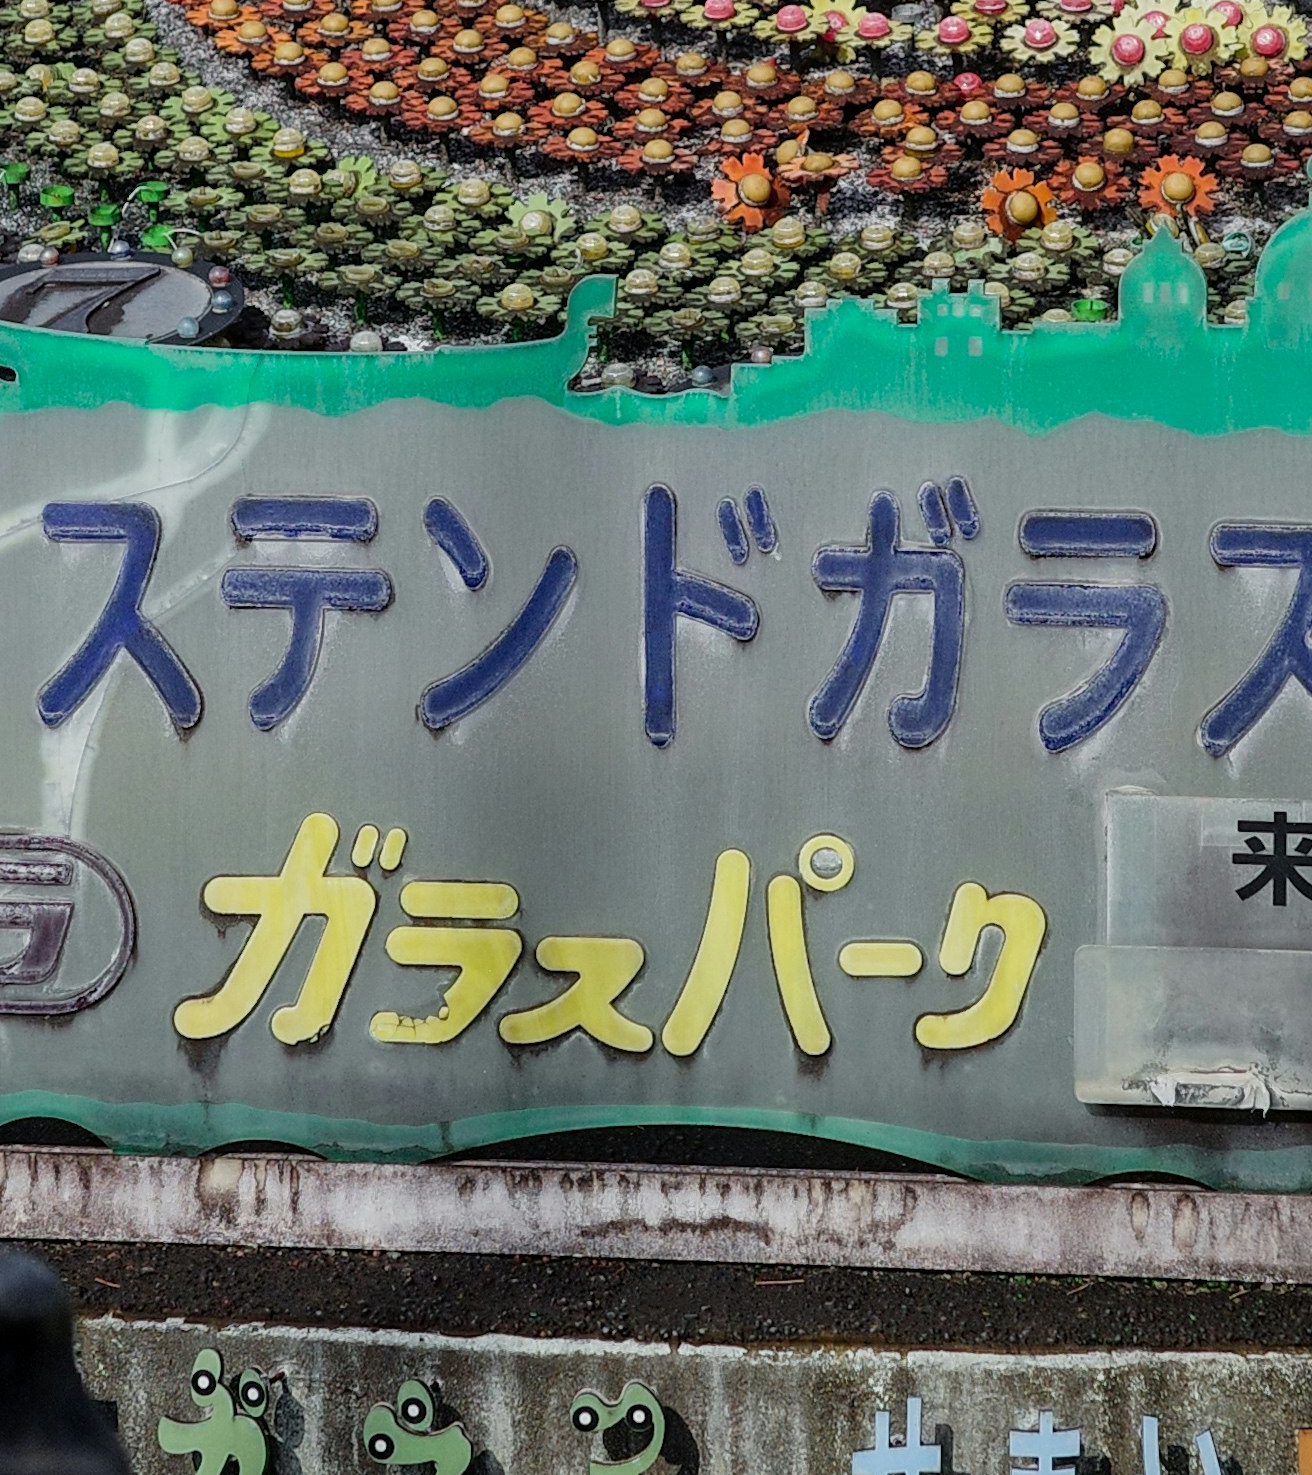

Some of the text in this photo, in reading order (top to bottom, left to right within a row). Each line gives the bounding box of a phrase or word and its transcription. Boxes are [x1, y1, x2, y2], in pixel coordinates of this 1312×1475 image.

[174, 811, 1048, 1057] ガラスパーク
